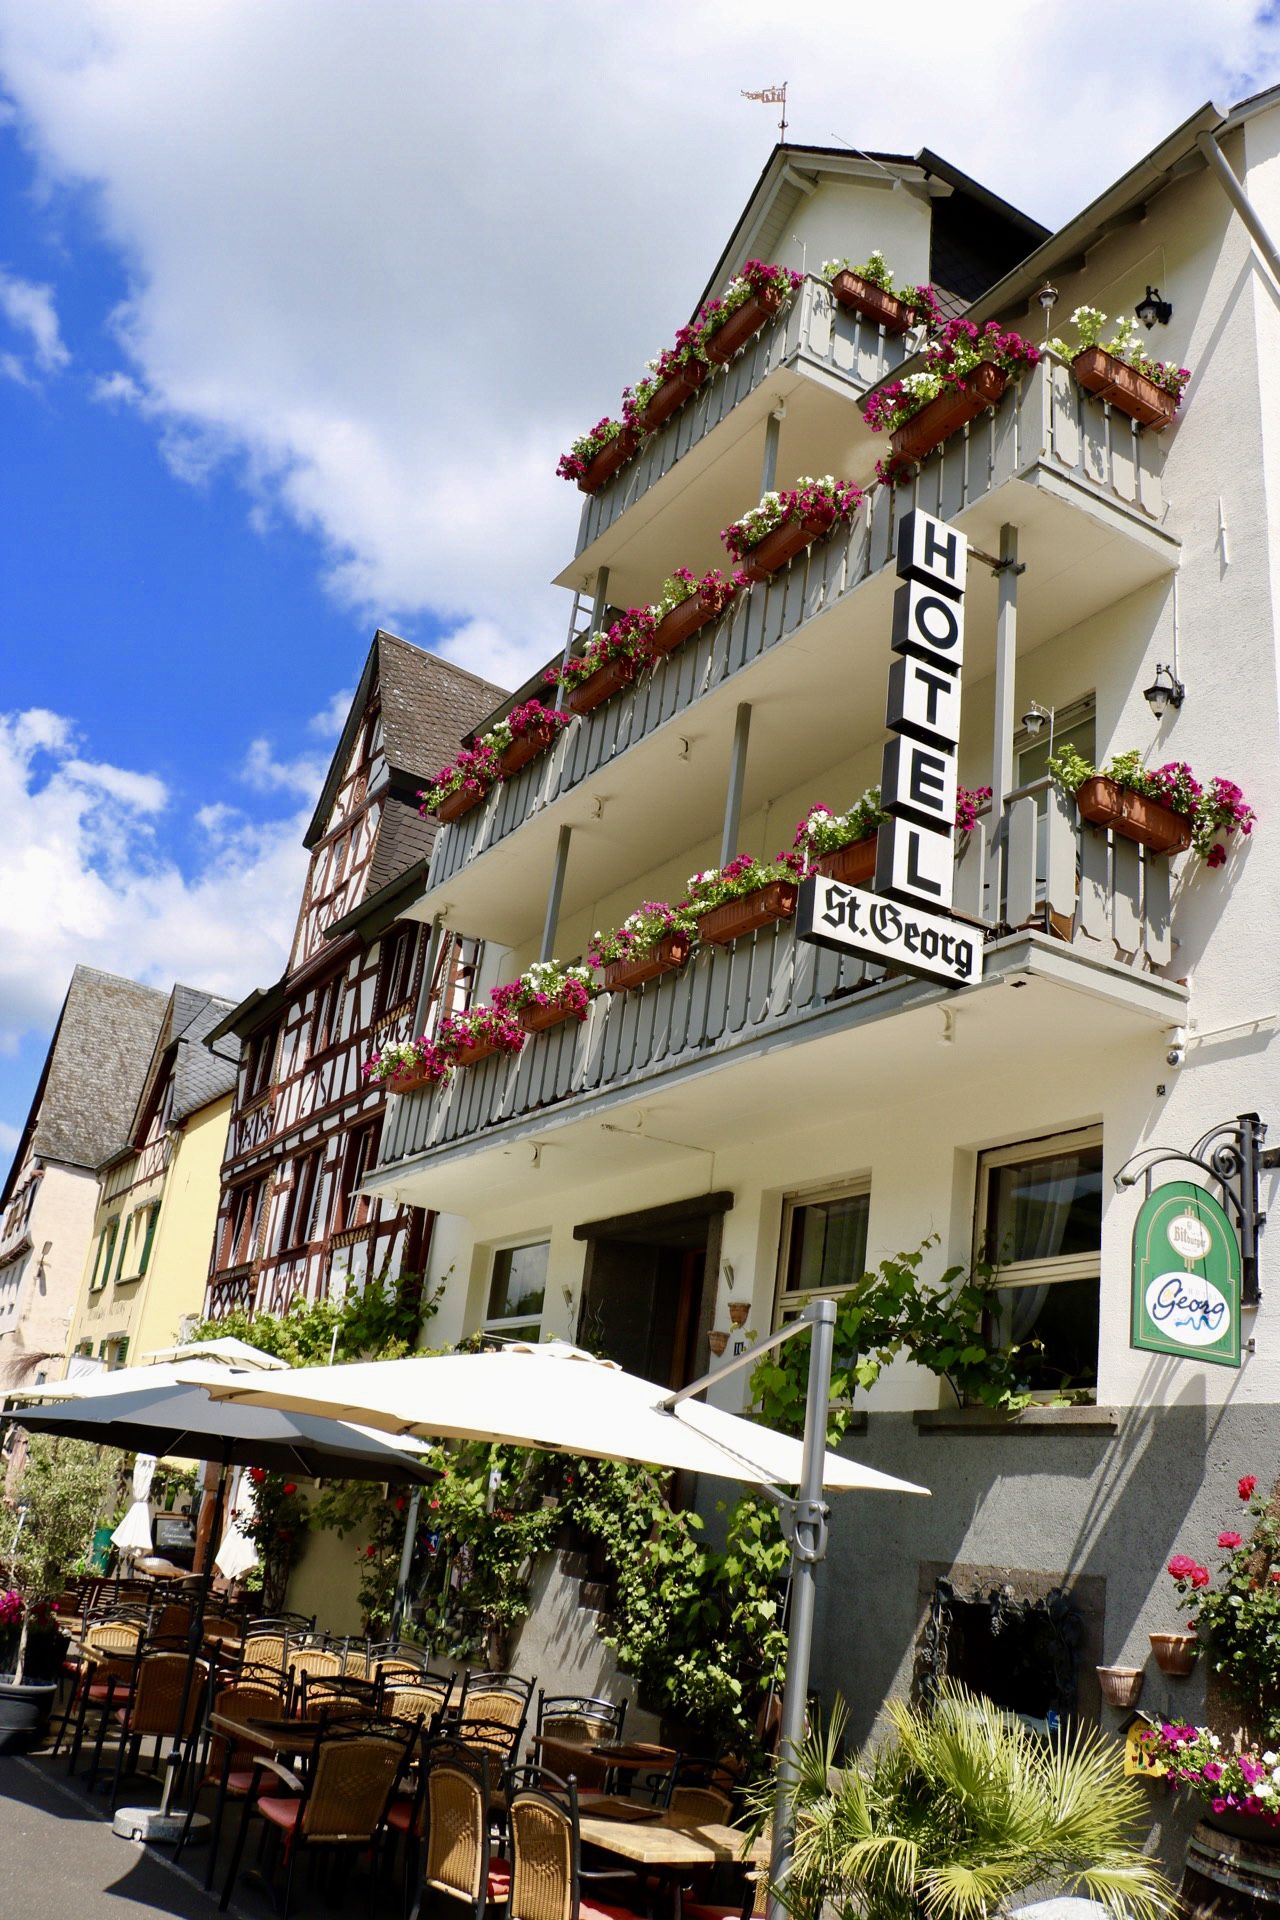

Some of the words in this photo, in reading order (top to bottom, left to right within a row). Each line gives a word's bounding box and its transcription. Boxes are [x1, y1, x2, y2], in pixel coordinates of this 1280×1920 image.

[906, 520, 960, 897] HOTEL
[869, 903, 973, 979] Georg
[1152, 1278, 1225, 1330] Georg
